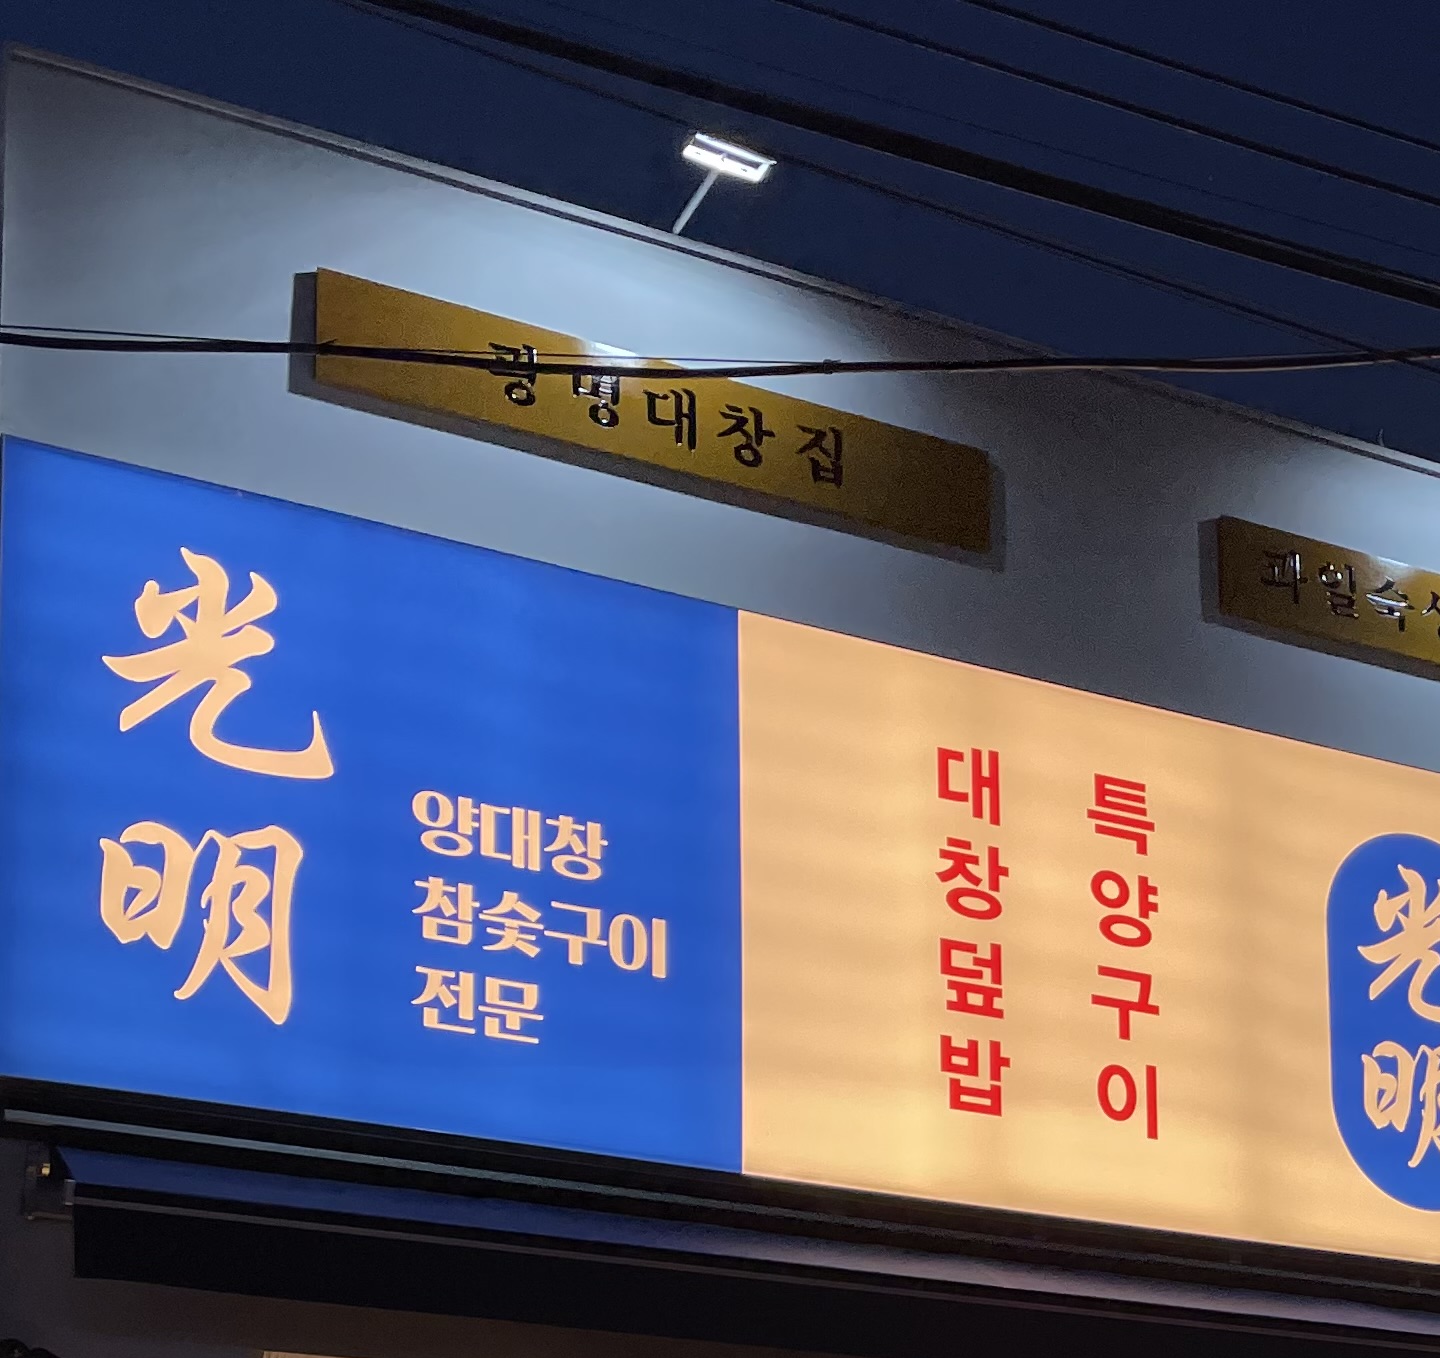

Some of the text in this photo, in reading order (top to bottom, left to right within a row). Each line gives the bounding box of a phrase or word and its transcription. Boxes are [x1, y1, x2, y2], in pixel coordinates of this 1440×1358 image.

[100, 547, 334, 1025] 光明
[412, 791, 608, 883] 양대창
[411, 966, 543, 1043] 전문
[412, 878, 666, 979] 참숯구이
[937, 748, 1010, 1116] 대창덮밥
[1088, 775, 1159, 1139] 특양구이
